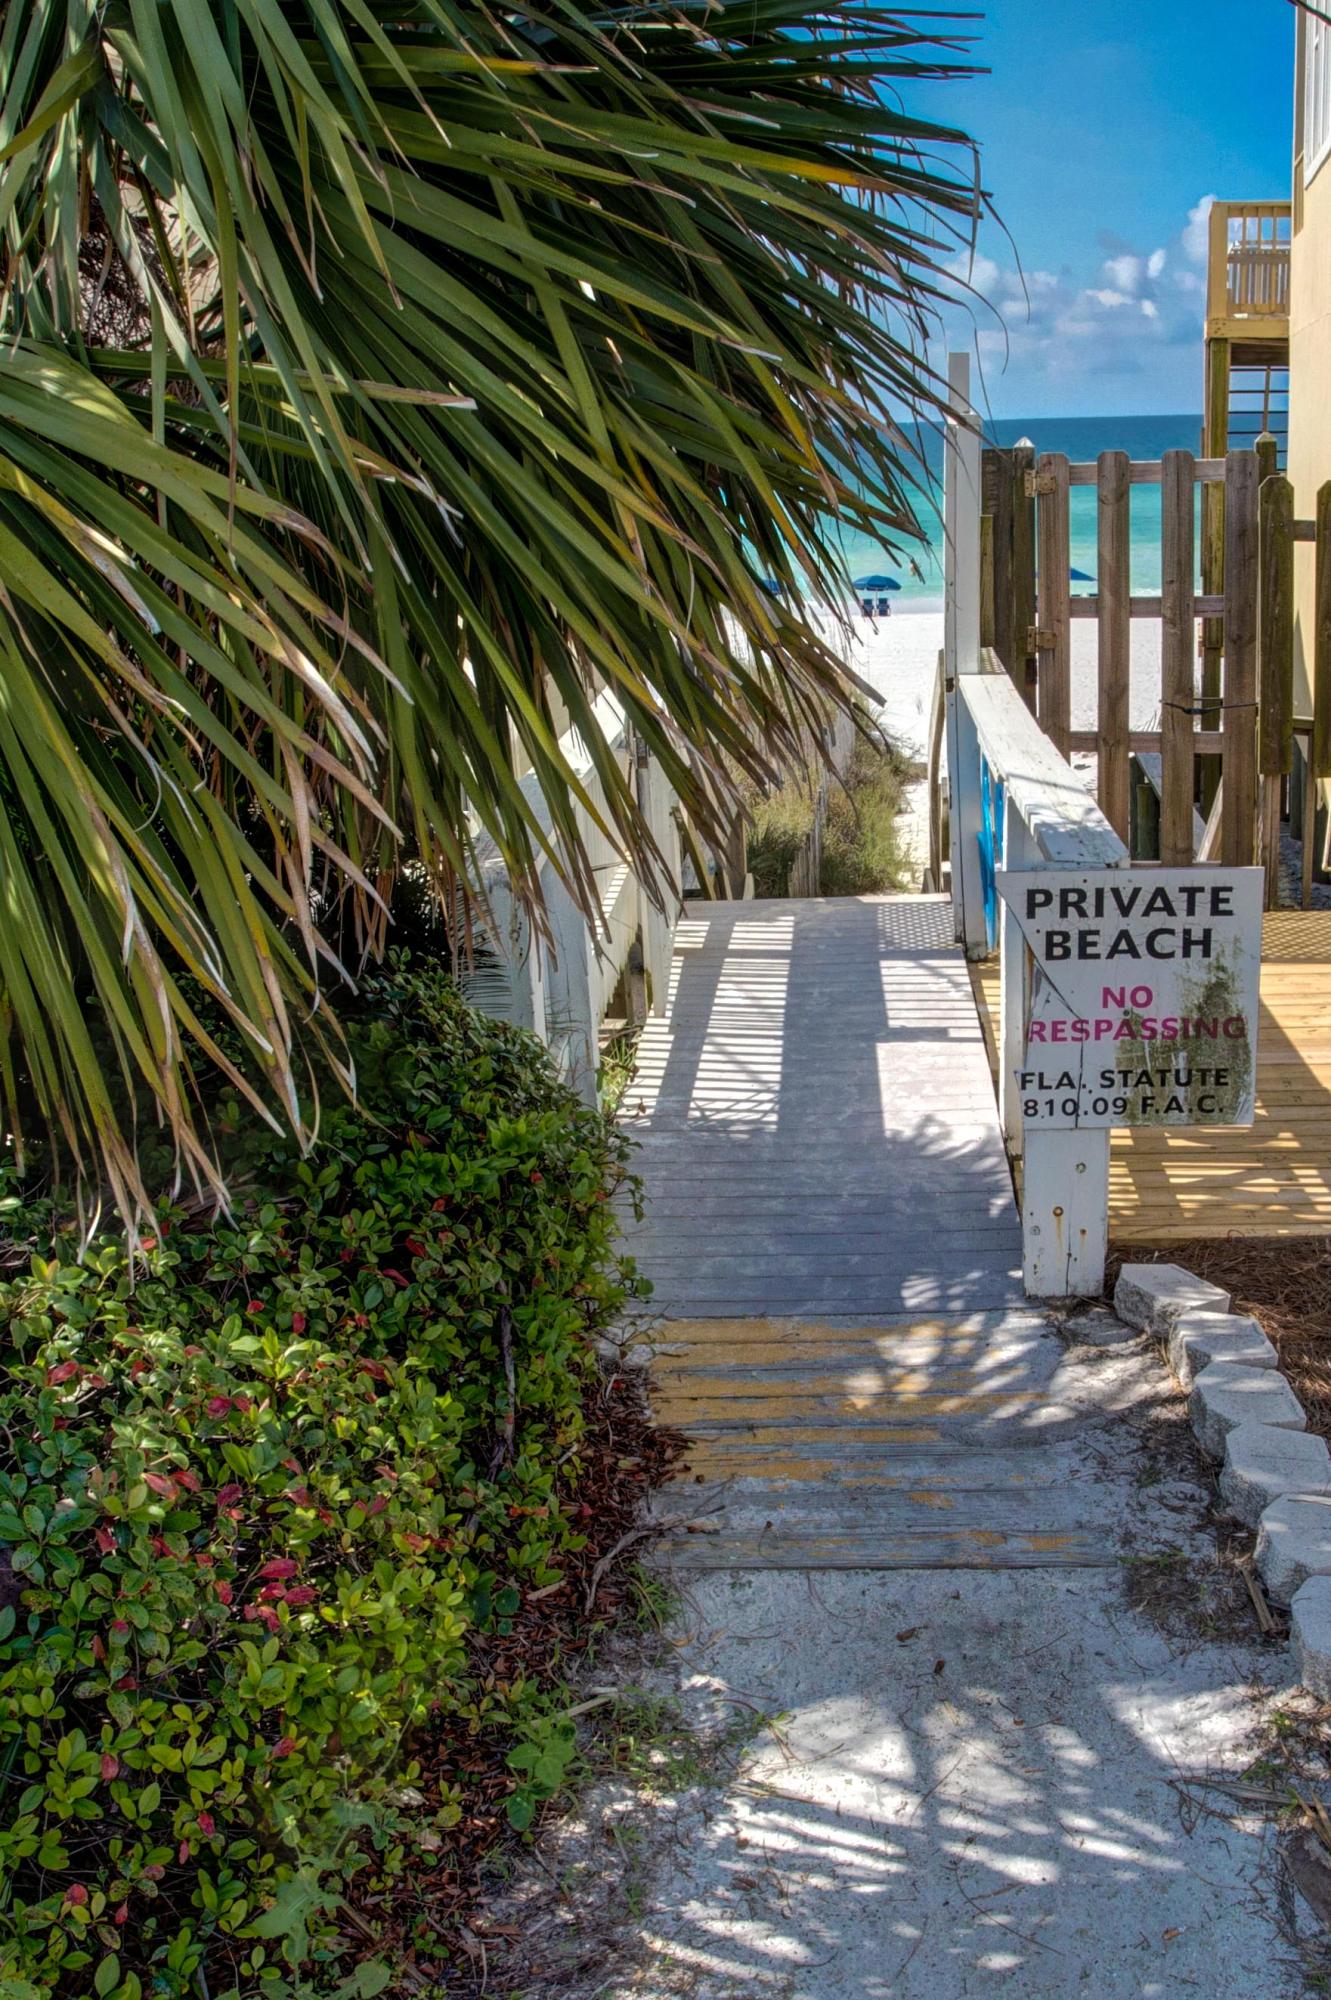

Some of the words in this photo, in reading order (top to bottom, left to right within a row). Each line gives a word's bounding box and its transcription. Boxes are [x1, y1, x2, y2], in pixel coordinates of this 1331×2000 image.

[1026, 886, 1234, 919] PRIVATE
[1045, 928, 1213, 961] BEACH
[1102, 985, 1154, 1009] NO
[1028, 1015, 1246, 1043] RESPASSING
[1020, 1071, 1087, 1091] FLA.
[1100, 1068, 1229, 1089] STATUTE
[1023, 1096, 1128, 1118] 810.09
